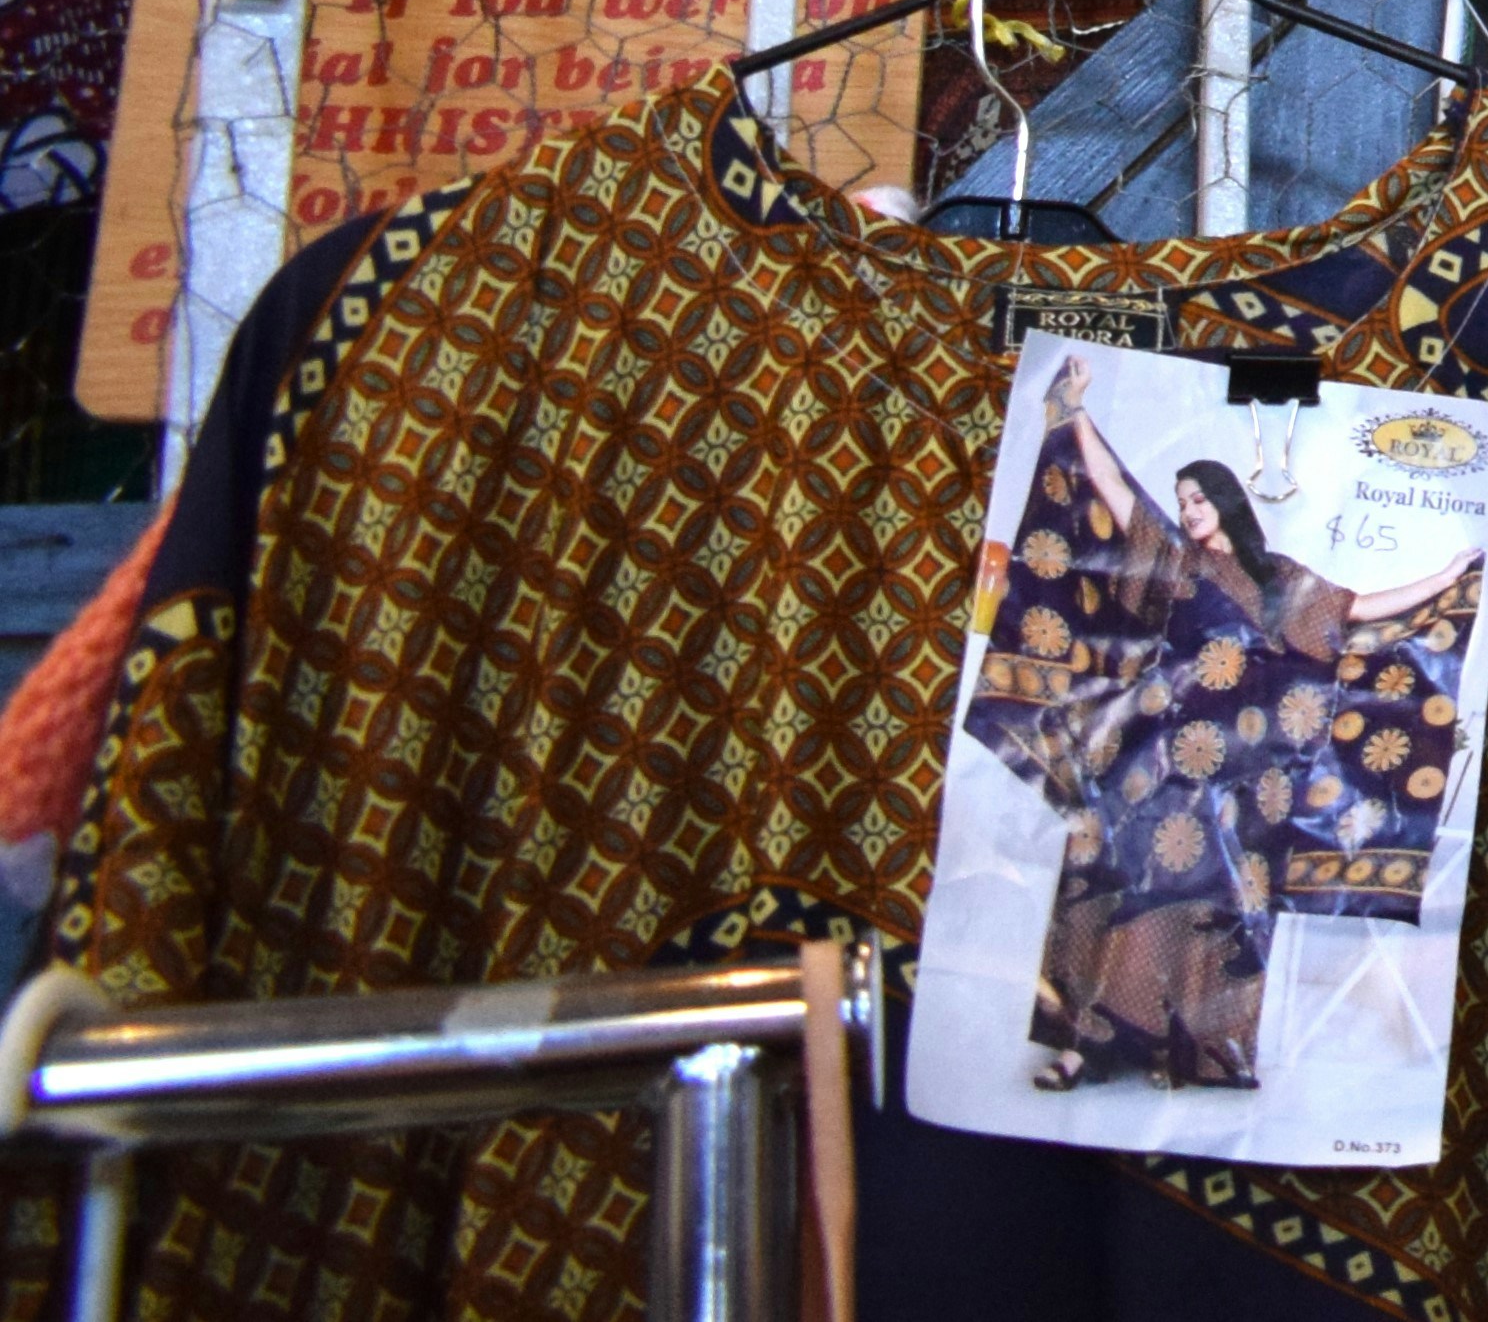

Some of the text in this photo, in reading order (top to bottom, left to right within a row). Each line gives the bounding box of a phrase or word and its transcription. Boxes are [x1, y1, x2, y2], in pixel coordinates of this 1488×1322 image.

[302, 36, 827, 94] ial for bein a
[1039, 311, 1136, 331] ROYAL
[1389, 439, 1463, 463] ROYAL
[1355, 481, 1486, 516] Royal Kijora
